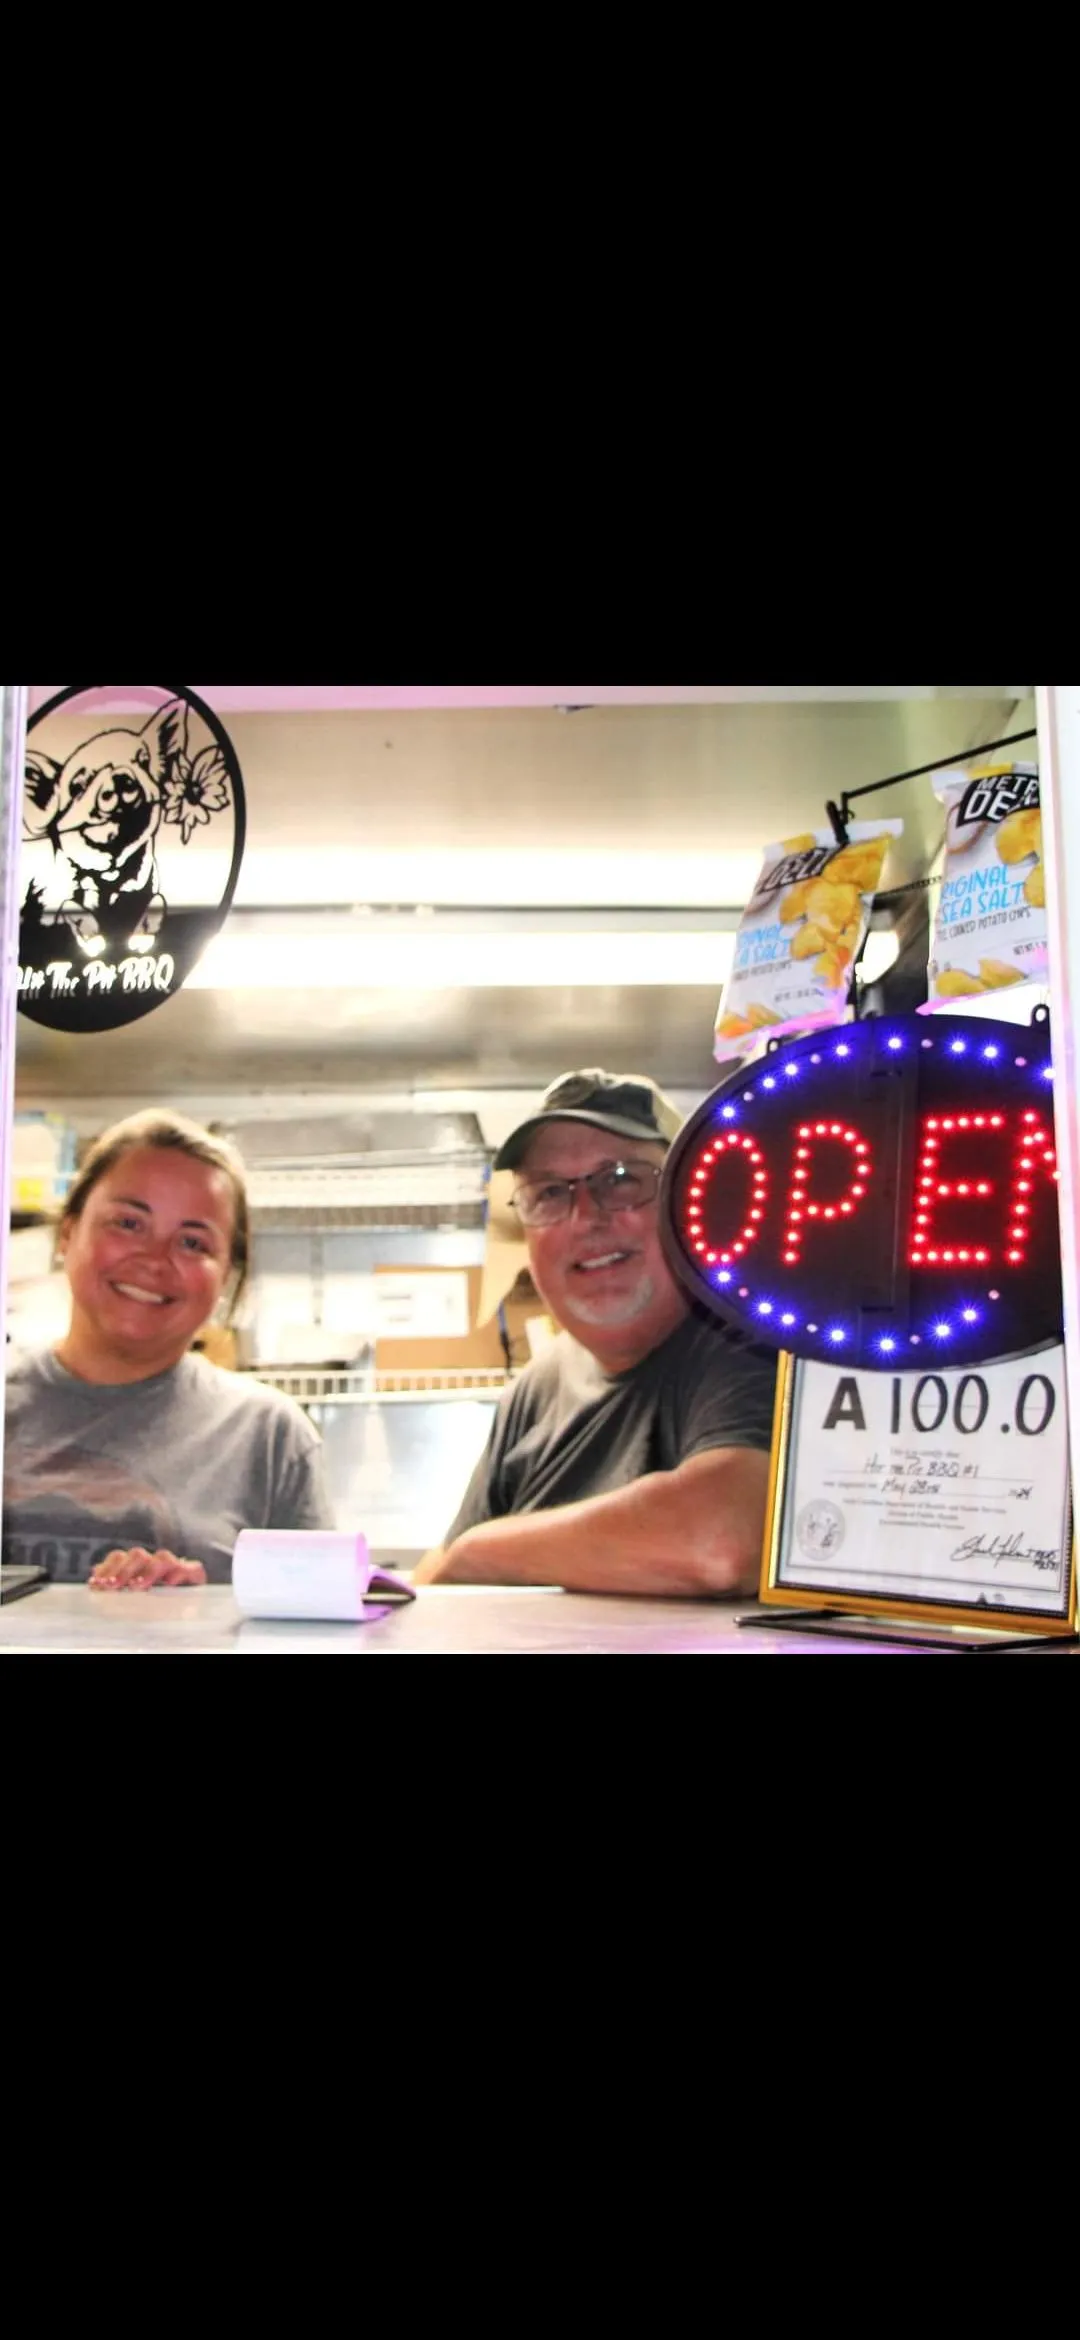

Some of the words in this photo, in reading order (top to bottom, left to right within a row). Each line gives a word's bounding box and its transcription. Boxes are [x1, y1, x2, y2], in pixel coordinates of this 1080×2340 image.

[942, 897, 971, 924] SEA
[977, 881, 1024, 914] SALT
[118, 954, 175, 991] BBQ
[822, 1377, 867, 1430] A
[890, 1374, 1056, 1436] 100.0
[926, 1461, 959, 1478] BBQ
